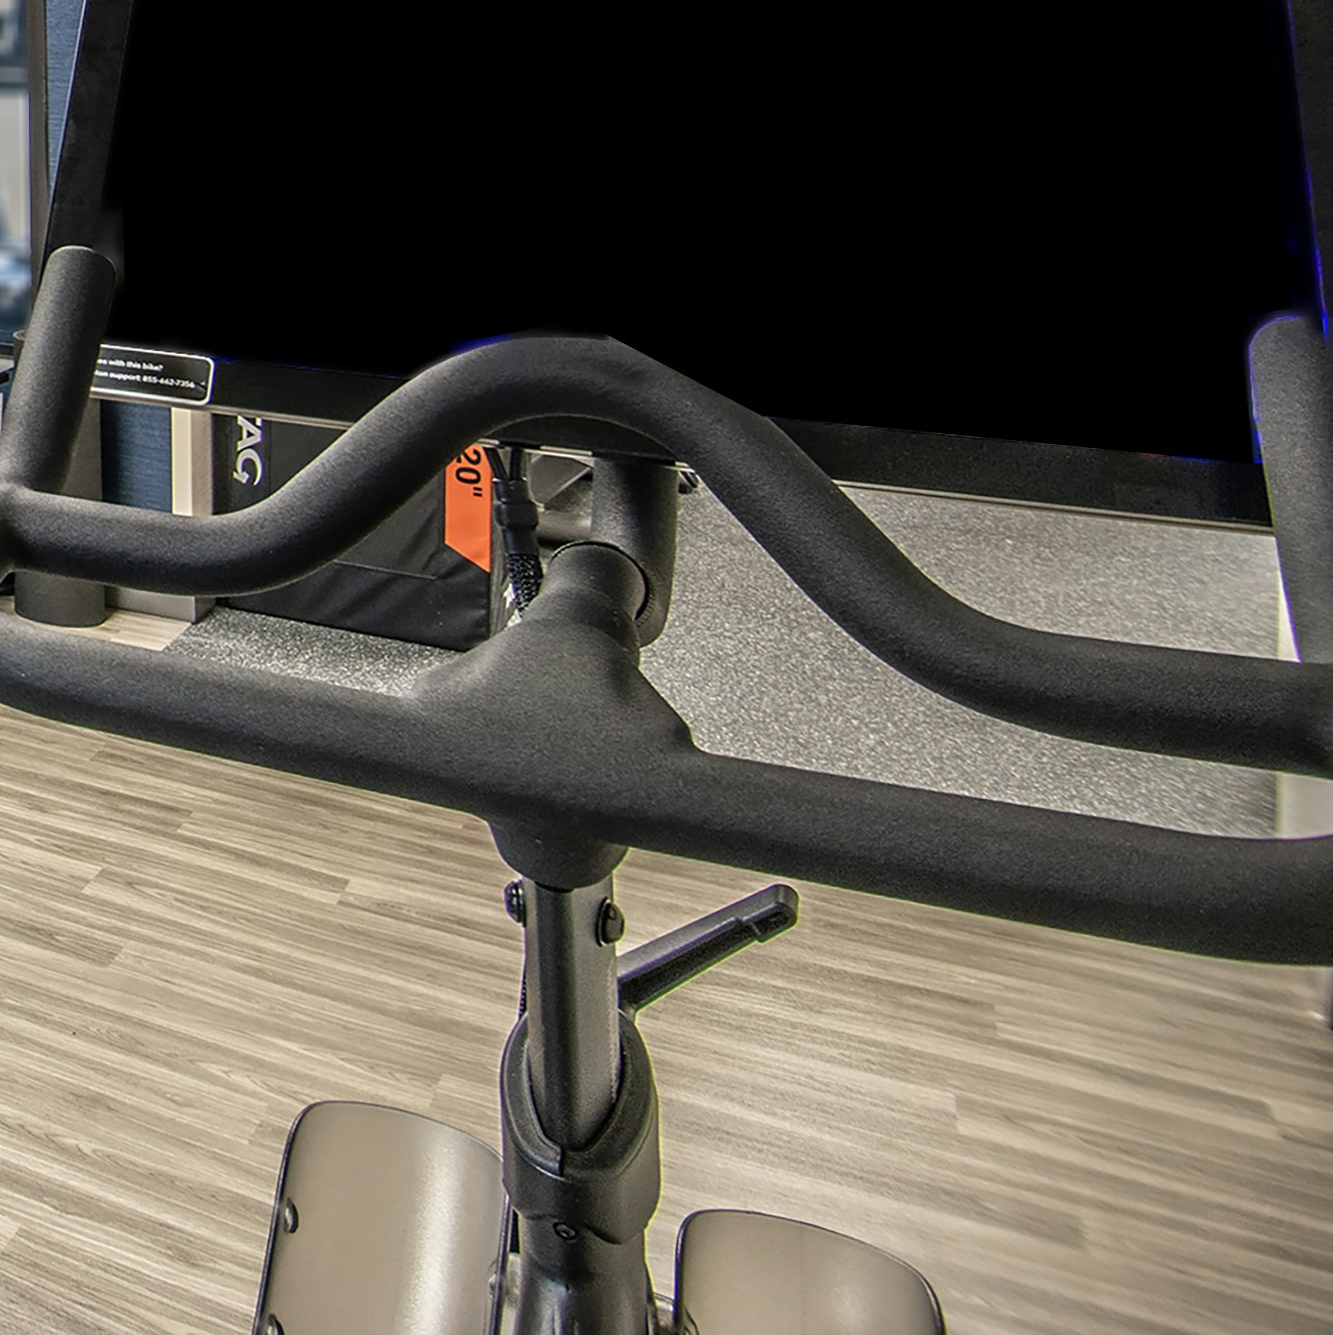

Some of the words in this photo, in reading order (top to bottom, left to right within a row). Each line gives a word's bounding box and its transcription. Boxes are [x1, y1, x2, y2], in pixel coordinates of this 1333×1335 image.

[108, 359, 125, 367] with
[126, 361, 141, 369] this
[142, 362, 164, 372] bike?
[233, 415, 263, 486] AG
